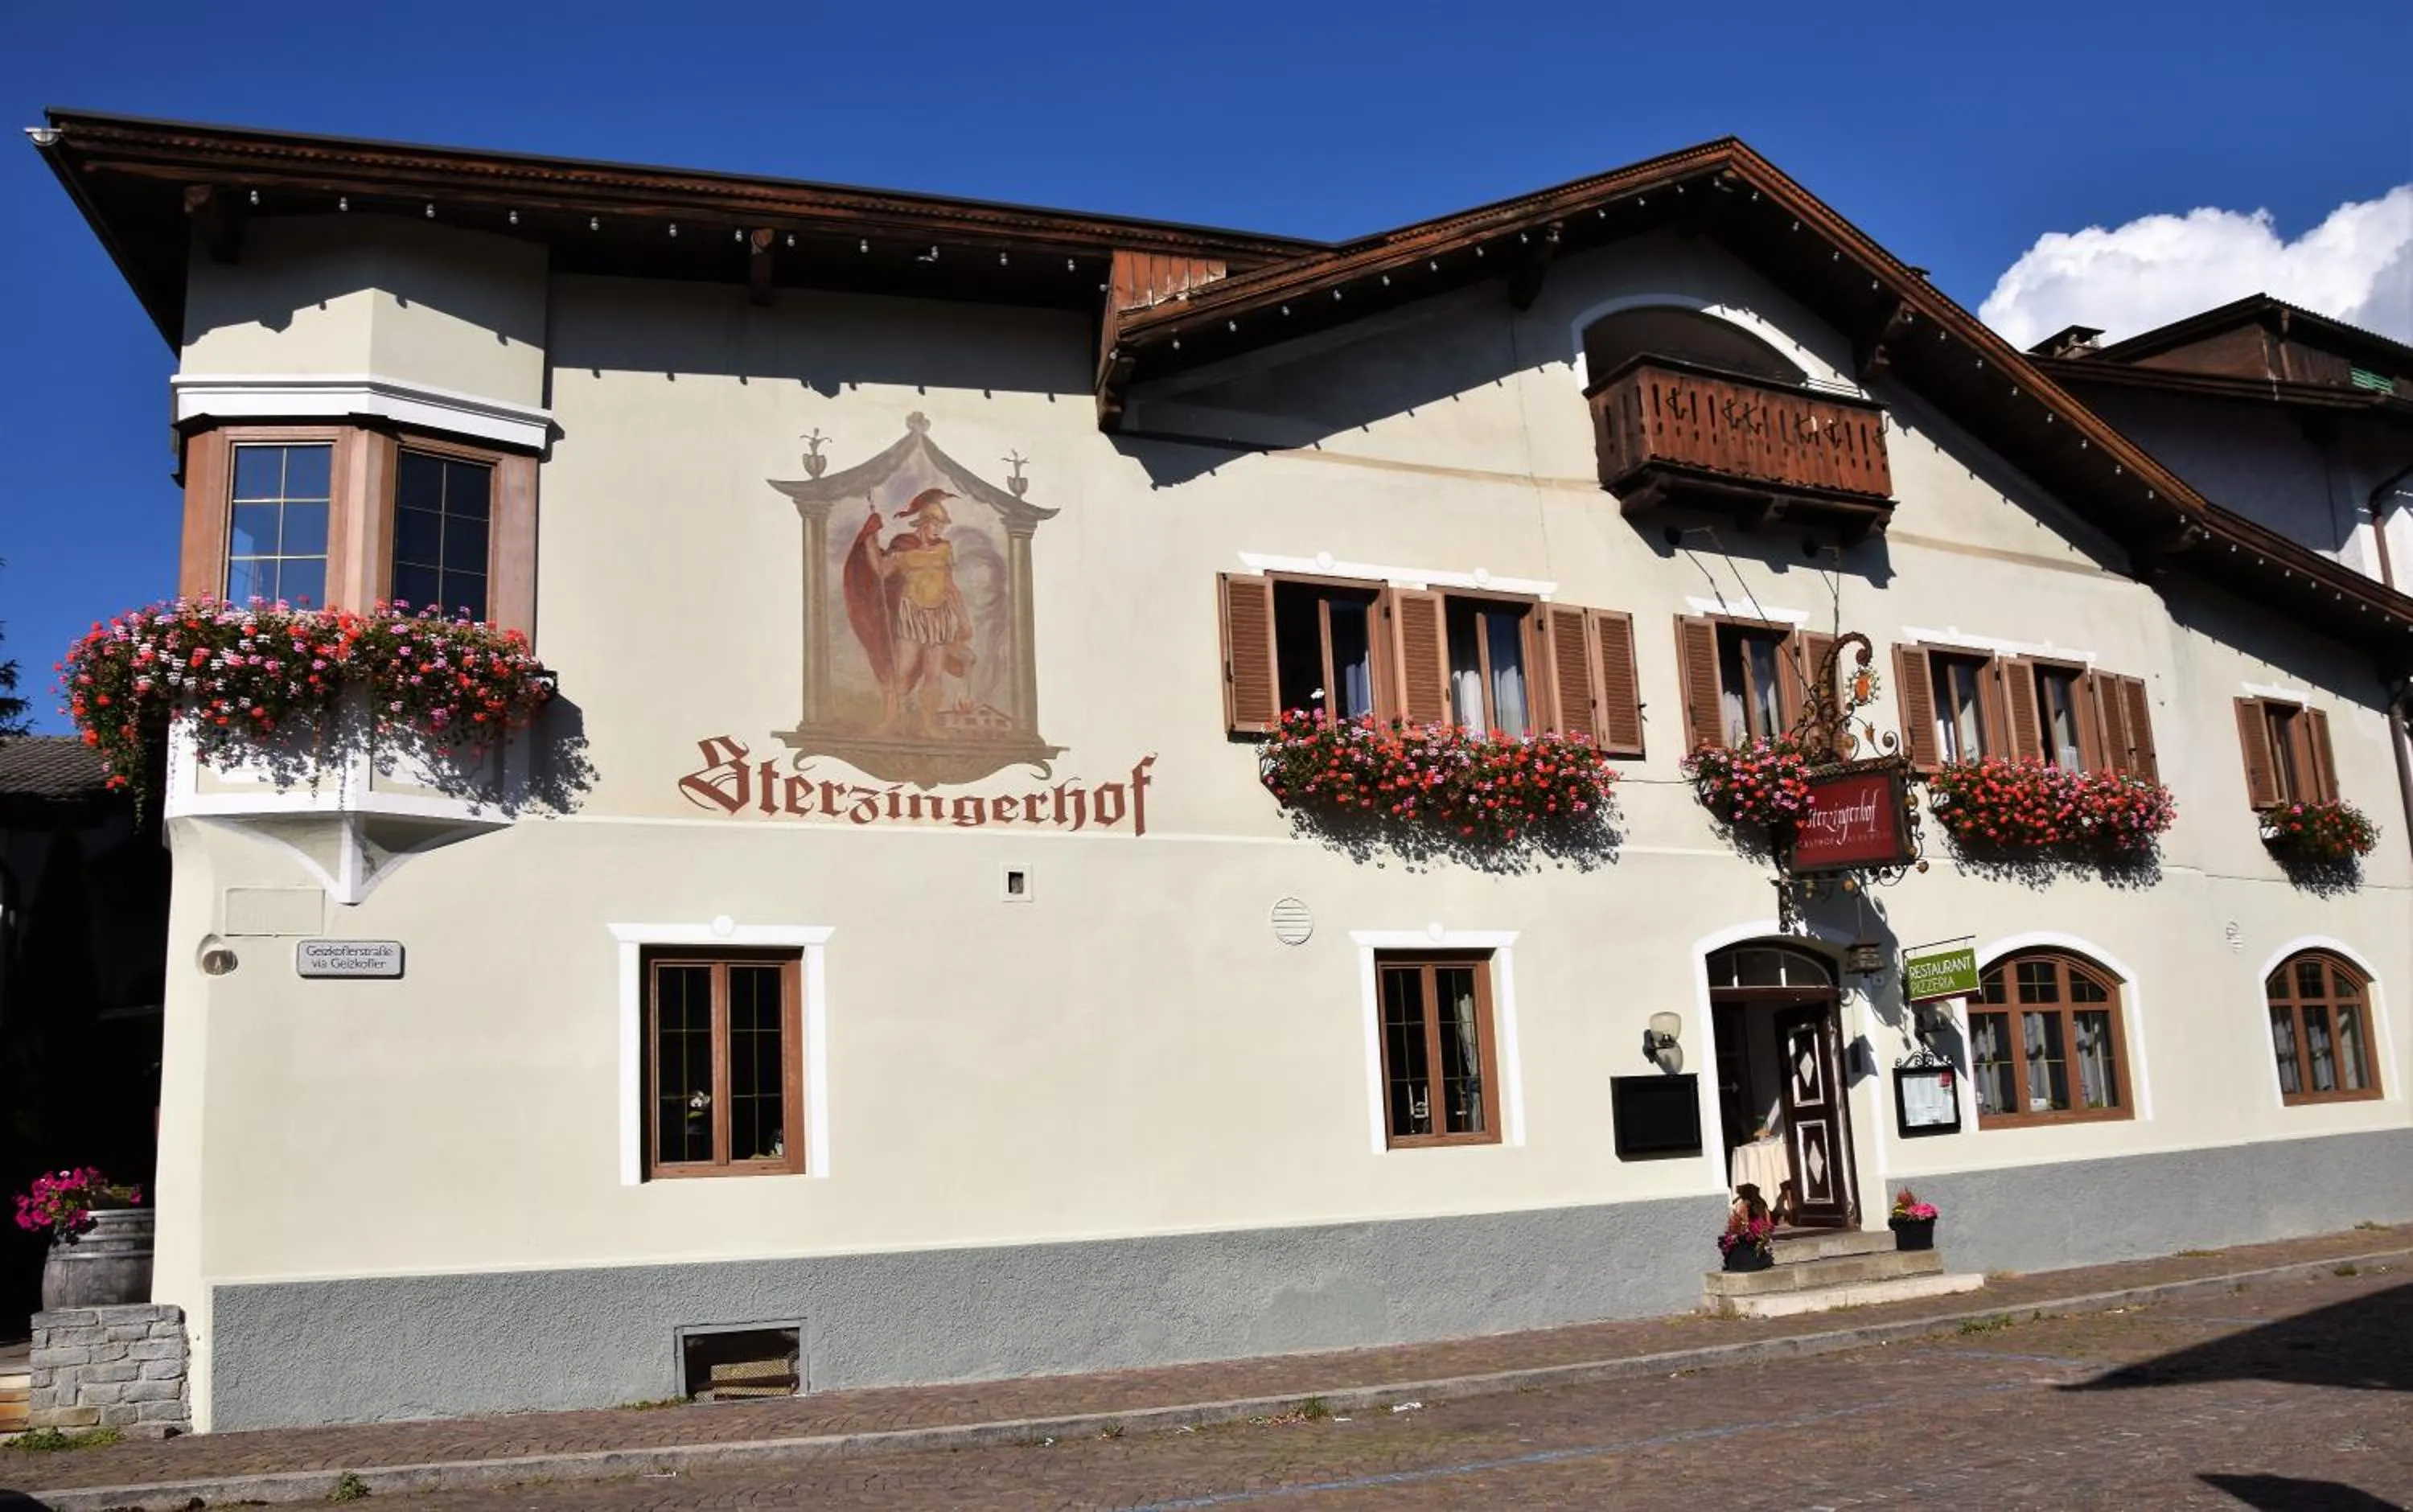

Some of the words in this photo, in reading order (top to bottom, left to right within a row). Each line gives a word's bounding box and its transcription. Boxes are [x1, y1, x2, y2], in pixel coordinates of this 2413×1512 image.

[679, 735, 1159, 837] Sterzingerhof
[331, 958, 387, 969] Geizkofler
[1909, 956, 1971, 980] RESTAURANT
[1909, 976, 1955, 995] PIZZERIA
